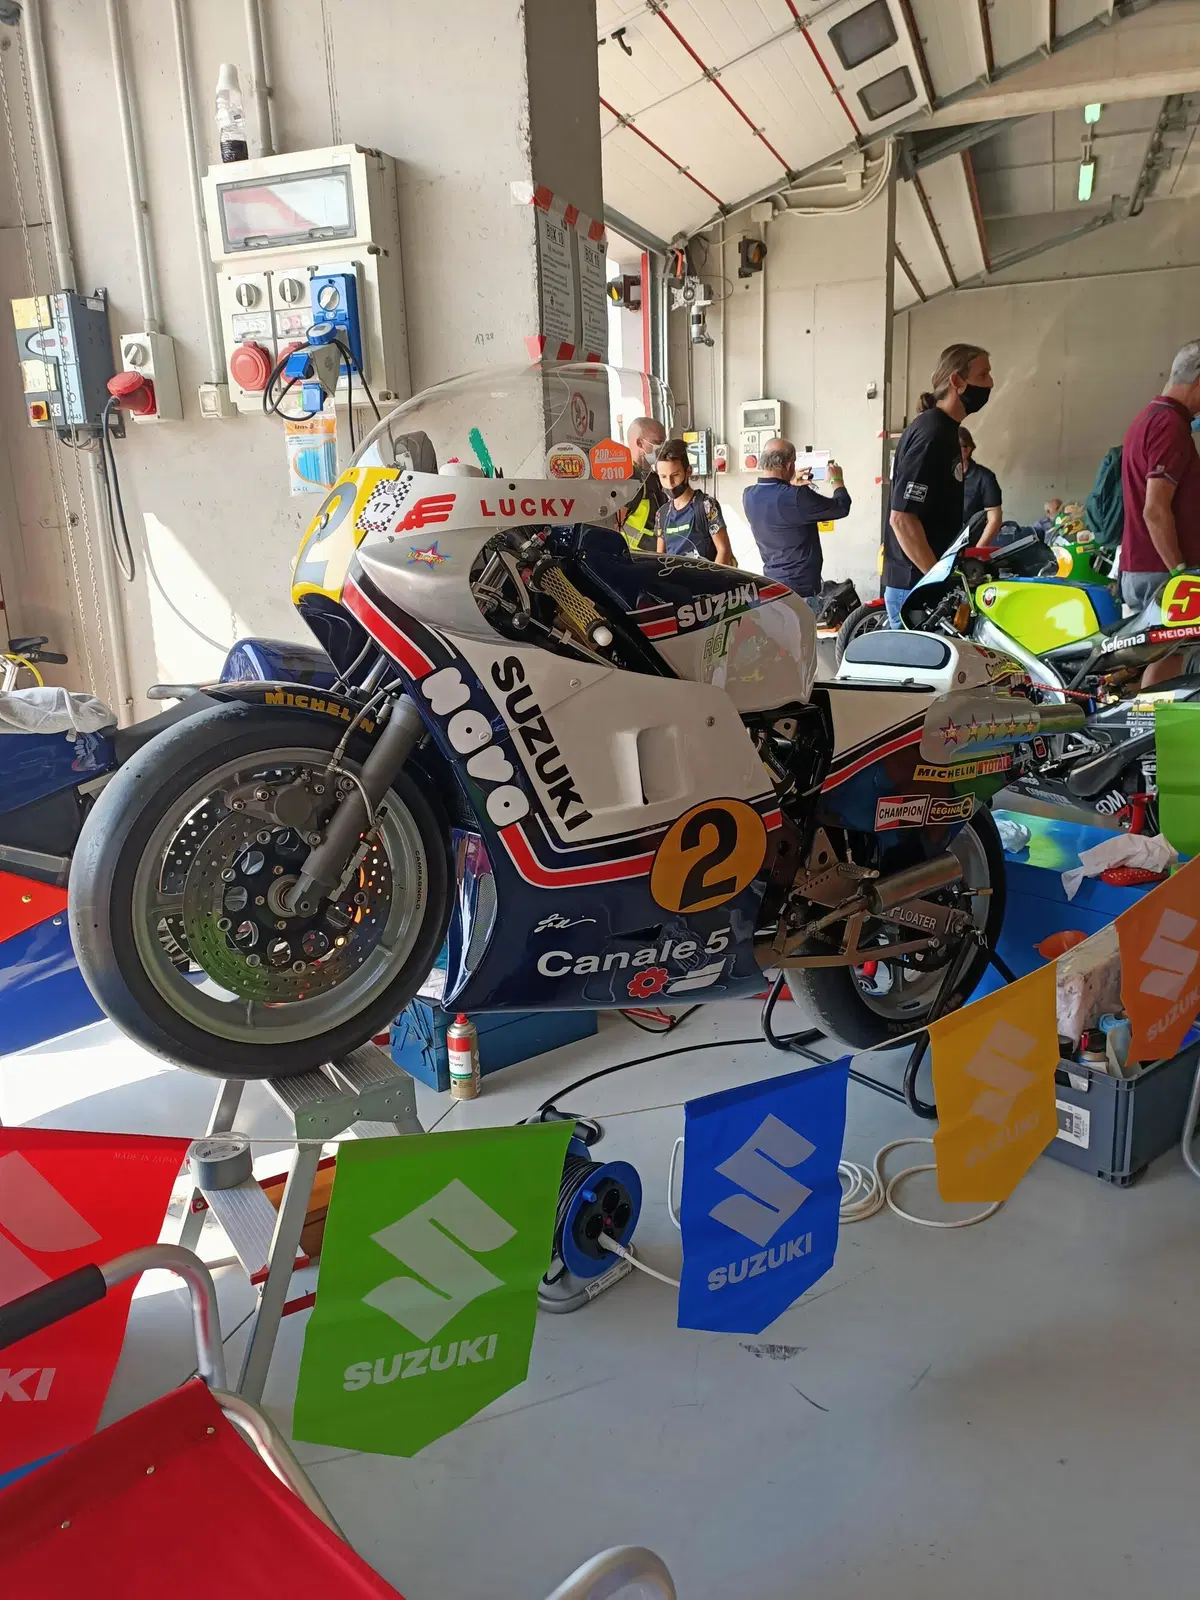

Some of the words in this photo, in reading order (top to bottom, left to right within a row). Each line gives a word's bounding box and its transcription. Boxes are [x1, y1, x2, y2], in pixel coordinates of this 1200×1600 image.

[373, 501, 391, 514] 17
[480, 498, 575, 517] LUCKY
[677, 582, 760, 628] SUZUKI
[1167, 580, 1200, 621] 5
[1100, 632, 1146, 654] Selema
[490, 655, 594, 832] SUZUKI
[916, 765, 976, 779] MICHELIN
[878, 804, 924, 819] CHAMPION
[930, 806, 961, 816] REGINA
[415, 850, 423, 910] CAMPAGNOLO
[678, 808, 738, 911] 2
[537, 939, 698, 978] Canale
[704, 927, 731, 954] 5
[114, 1152, 137, 1161] MADE
[141, 1153, 149, 1162] IN
[153, 1155, 178, 1165] JAPAN
[707, 1231, 812, 1292] SUZUKI
[343, 1333, 498, 1392] SUZUKI
